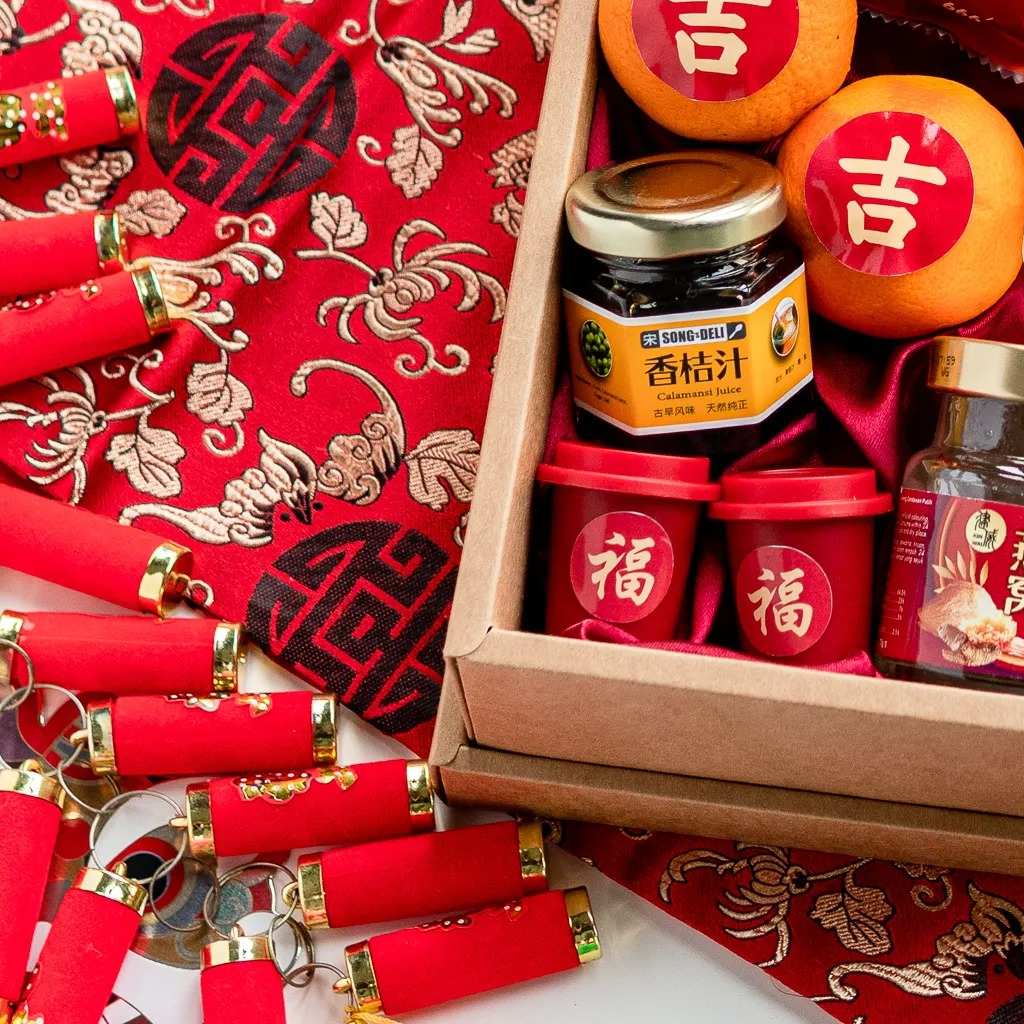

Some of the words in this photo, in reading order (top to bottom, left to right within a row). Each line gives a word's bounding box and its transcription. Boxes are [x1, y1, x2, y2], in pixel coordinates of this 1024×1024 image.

[838, 135, 947, 251] 吉
[644, 347, 749, 387] 香桔汁
[657, 388, 713, 401] Calamansi
[716, 386, 742, 396] Juice
[586, 532, 656, 606] 福
[747, 567, 814, 638] 福
